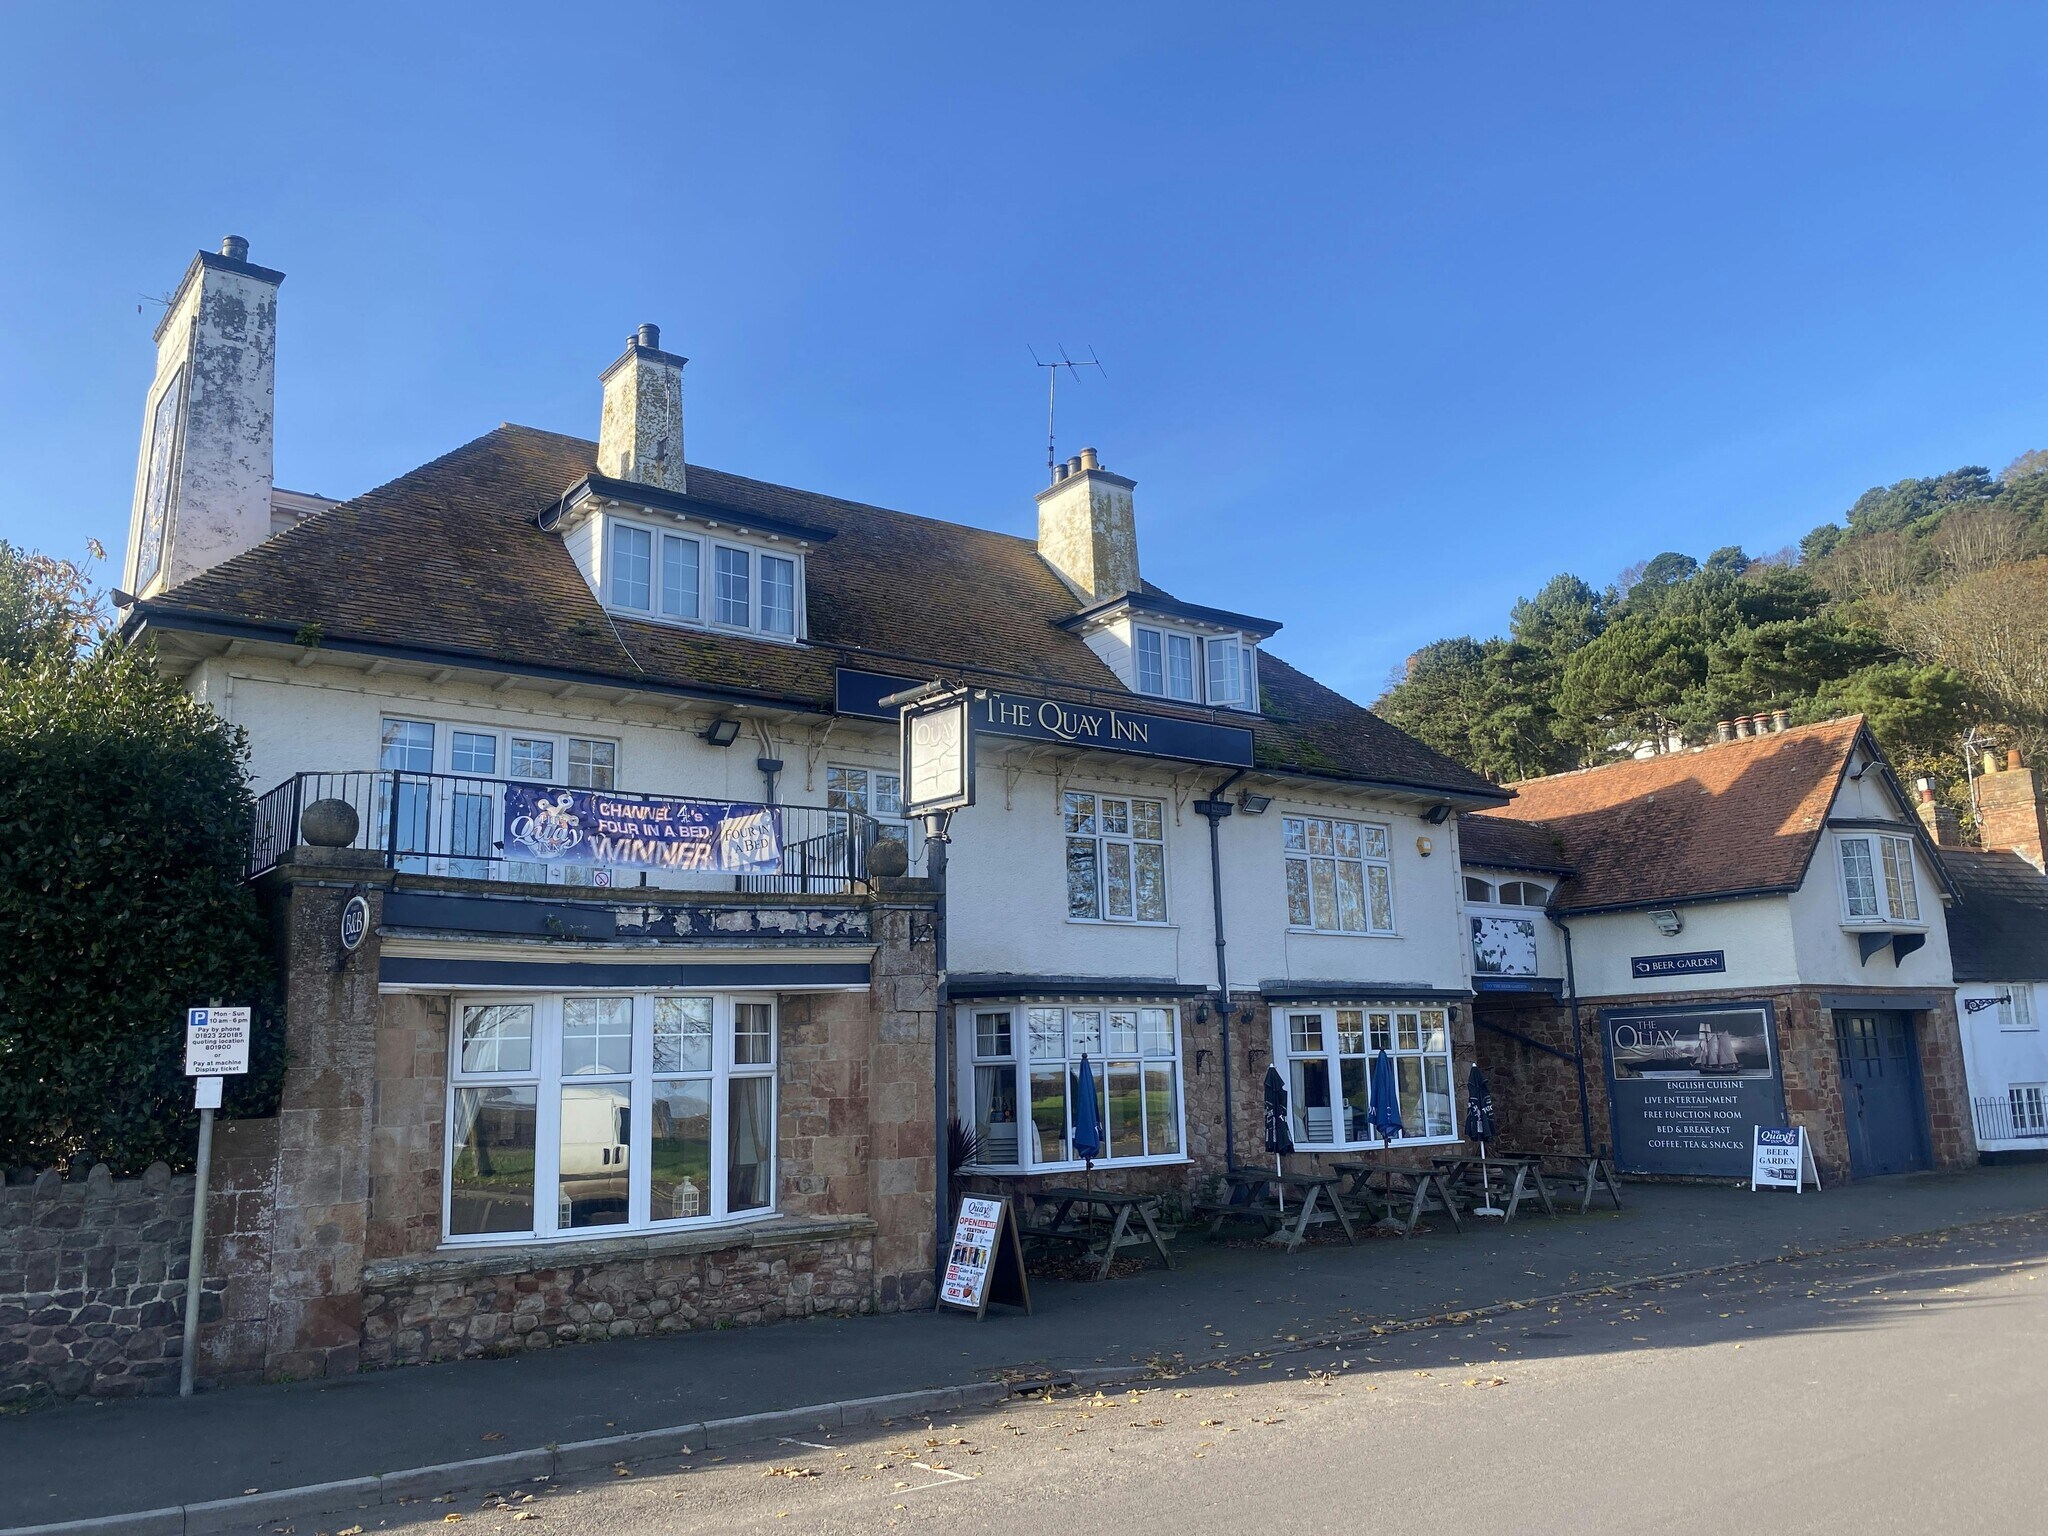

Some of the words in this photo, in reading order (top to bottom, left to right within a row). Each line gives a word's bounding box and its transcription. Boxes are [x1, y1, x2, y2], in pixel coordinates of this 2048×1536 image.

[987, 694, 1031, 727] THE
[1038, 701, 1103, 740] QUAY
[1110, 711, 1149, 743] INN
[916, 721, 958, 744] QUAY
[600, 803, 673, 821] CHANNEL
[541, 814, 564, 826] THE
[511, 815, 583, 849] Quay
[598, 819, 639, 835] FOUR
[643, 823, 660, 836] IN
[664, 825, 676, 838] A
[725, 826, 756, 841] FOUR
[758, 824, 770, 835] IN
[537, 840, 560, 853] INN
[735, 844, 743, 853] A
[744, 838, 769, 851] BED
[588, 835, 710, 870] WINNER
[1652, 961, 1675, 970] BEER
[1677, 957, 1718, 969] GARDEN
[1637, 1020, 1658, 1030] THE
[1614, 1024, 1680, 1056] QUAY
[1663, 1048, 1682, 1059] INN
[1666, 1081, 1705, 1090] ENGLISH
[1706, 1080, 1745, 1089] CUISINE
[1643, 1096, 1662, 1104] LIVE
[1663, 1095, 1738, 1104] ENTERTAINMENT
[1643, 1110, 1664, 1119] FREE
[1665, 1110, 1712, 1119] FUNCTION
[1713, 1110, 1742, 1119] ROOM
[1656, 1125, 1674, 1133] BED
[1675, 1125, 1683, 1133] &
[1683, 1125, 1731, 1134] BREAKFAST
[1761, 1131, 1788, 1142] Quay
[1683, 1140, 1700, 1149] TEA
[1701, 1141, 1708, 1149] &
[1709, 1140, 1744, 1150] SNACKS
[968, 1202, 988, 1216] Quay
[960, 1217, 977, 1227] OPEN
